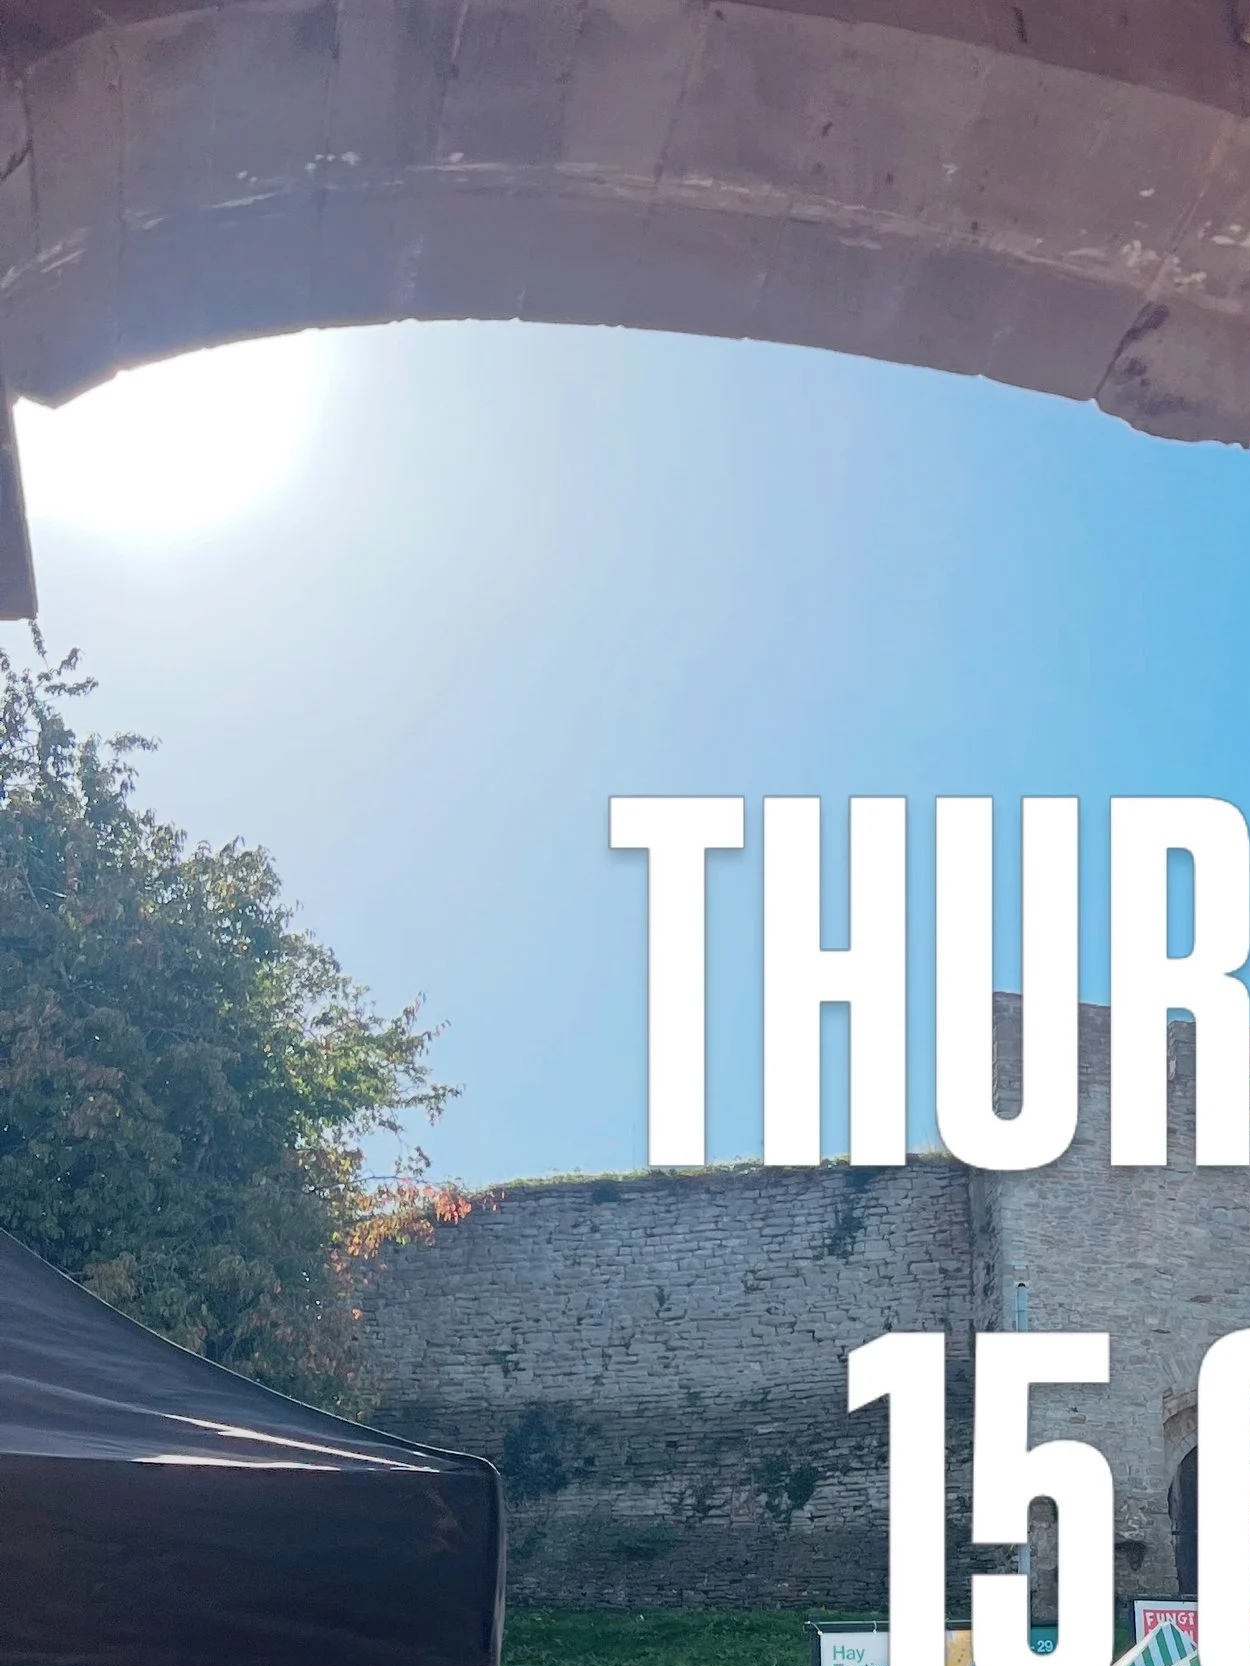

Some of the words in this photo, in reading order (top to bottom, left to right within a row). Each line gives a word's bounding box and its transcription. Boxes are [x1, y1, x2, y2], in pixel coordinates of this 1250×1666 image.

[1145, 1612, 1195, 1626] FUNGI
[1037, 1640, 1054, 1652] 29
[832, 1645, 865, 1664] Hay
